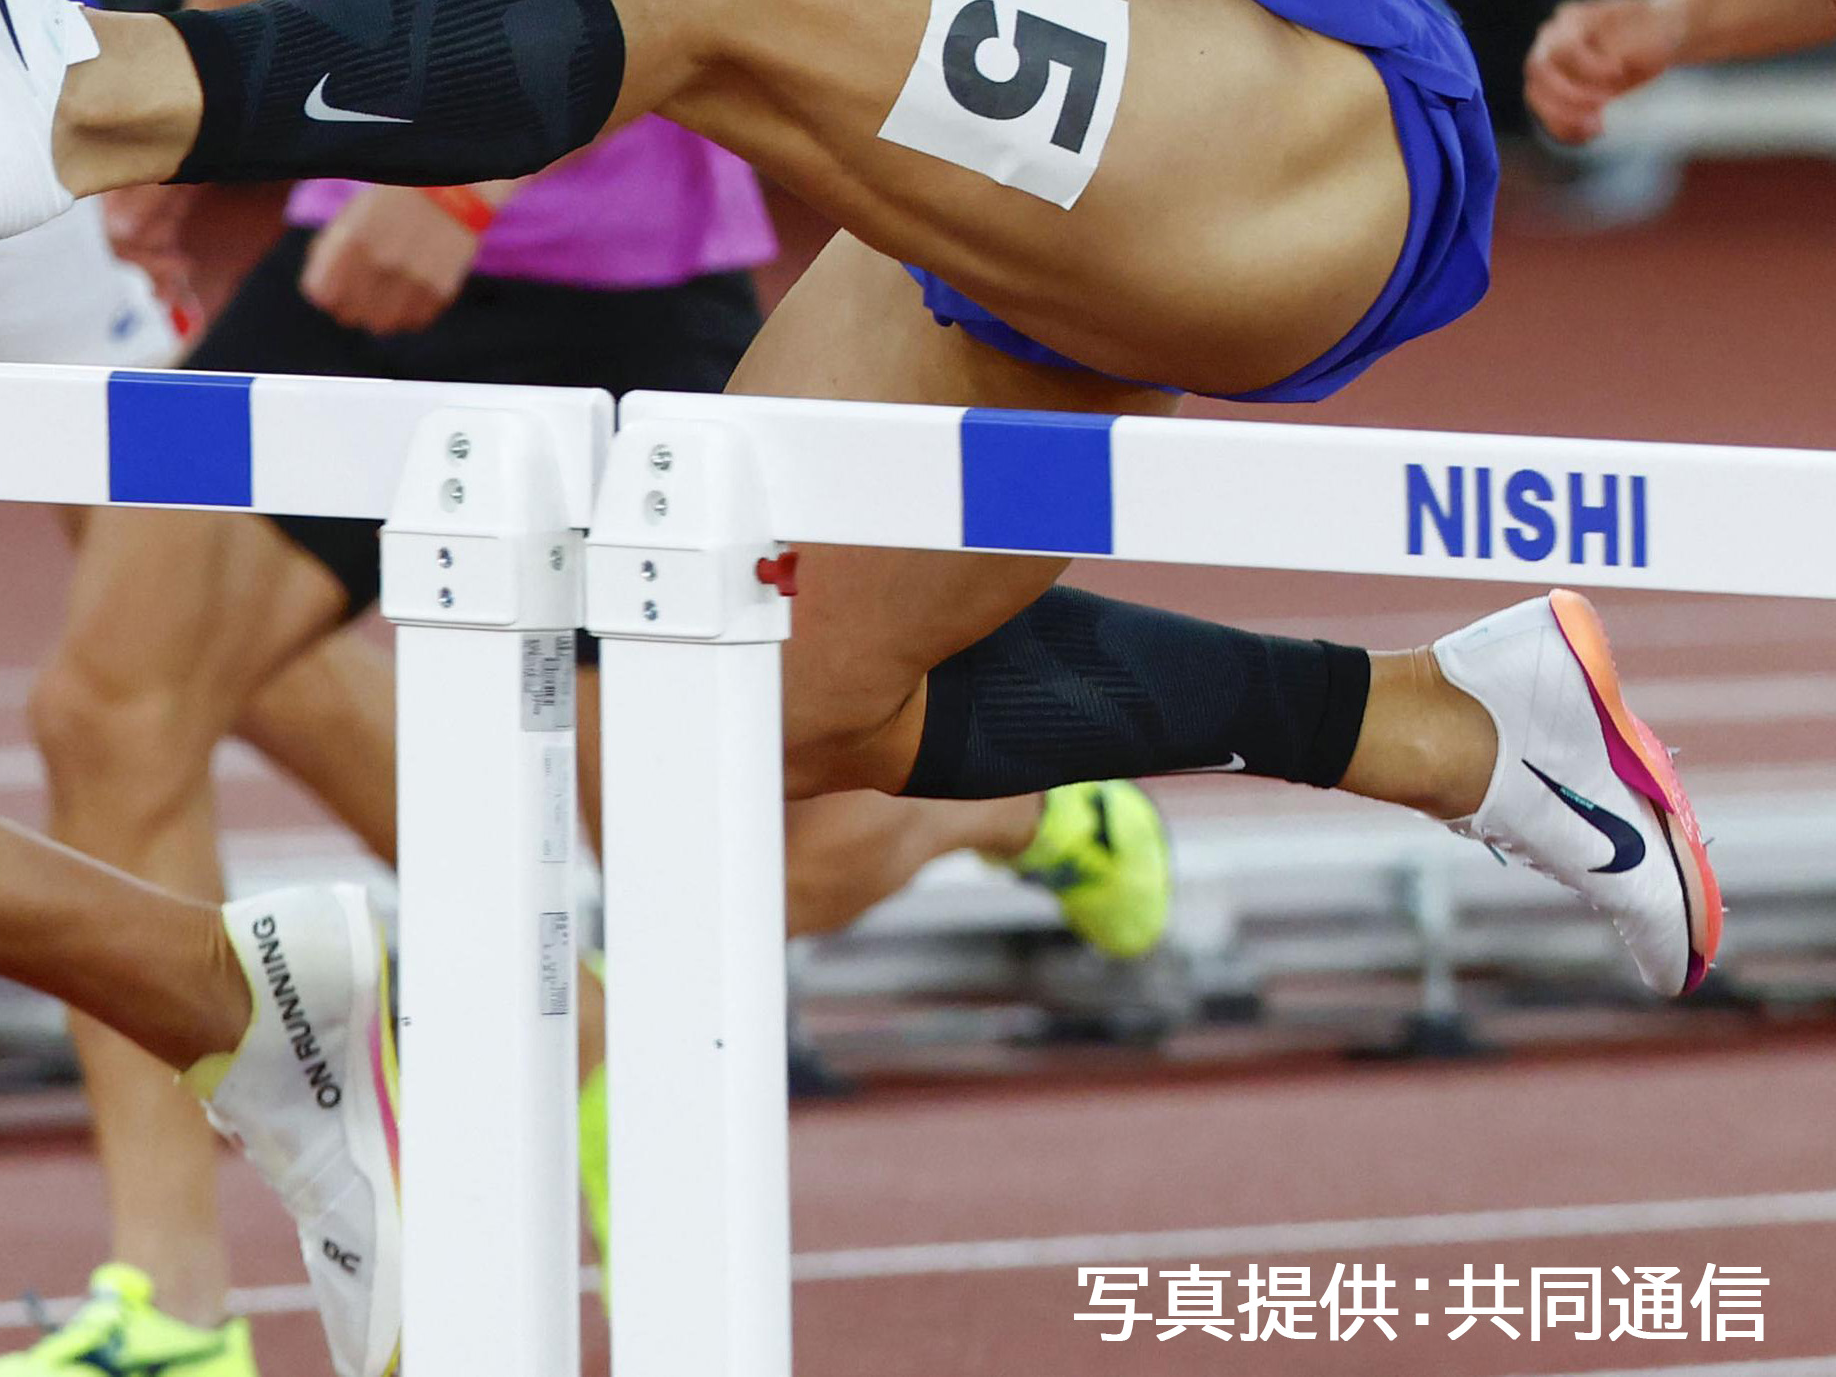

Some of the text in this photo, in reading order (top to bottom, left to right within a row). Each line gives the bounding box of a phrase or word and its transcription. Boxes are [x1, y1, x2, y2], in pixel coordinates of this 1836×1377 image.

[1404, 462, 1648, 568] NISHI
[252, 914, 342, 1109] ON RUNNING
